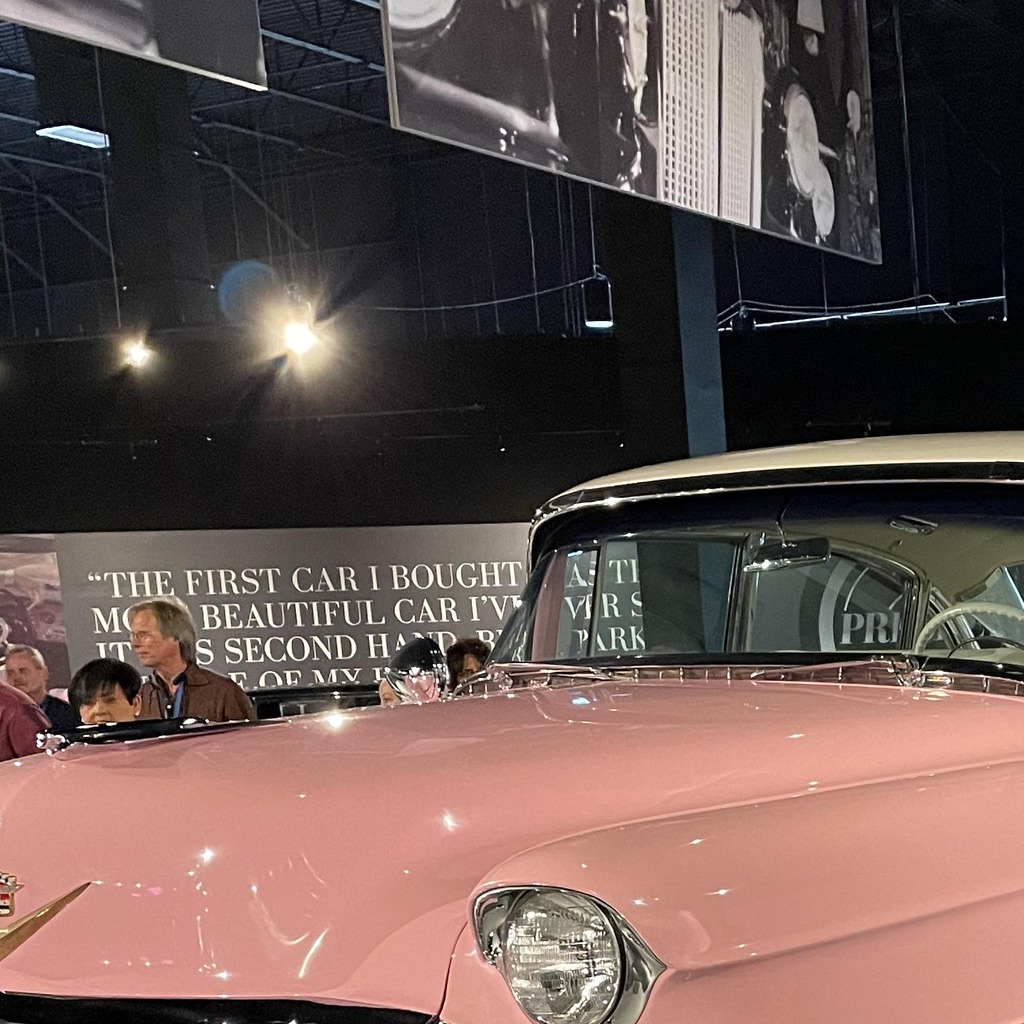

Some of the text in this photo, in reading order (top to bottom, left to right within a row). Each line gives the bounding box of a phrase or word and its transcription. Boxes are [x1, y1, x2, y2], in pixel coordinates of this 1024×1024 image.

[183, 567, 281, 596] FIRST
[291, 565, 359, 593] CAR
[368, 565, 381, 591] I
[389, 561, 523, 590] BOUGHT
[200, 599, 386, 631] BEAUTIFUL
[393, 596, 460, 625] CAR
[224, 635, 358, 664] SECOND
